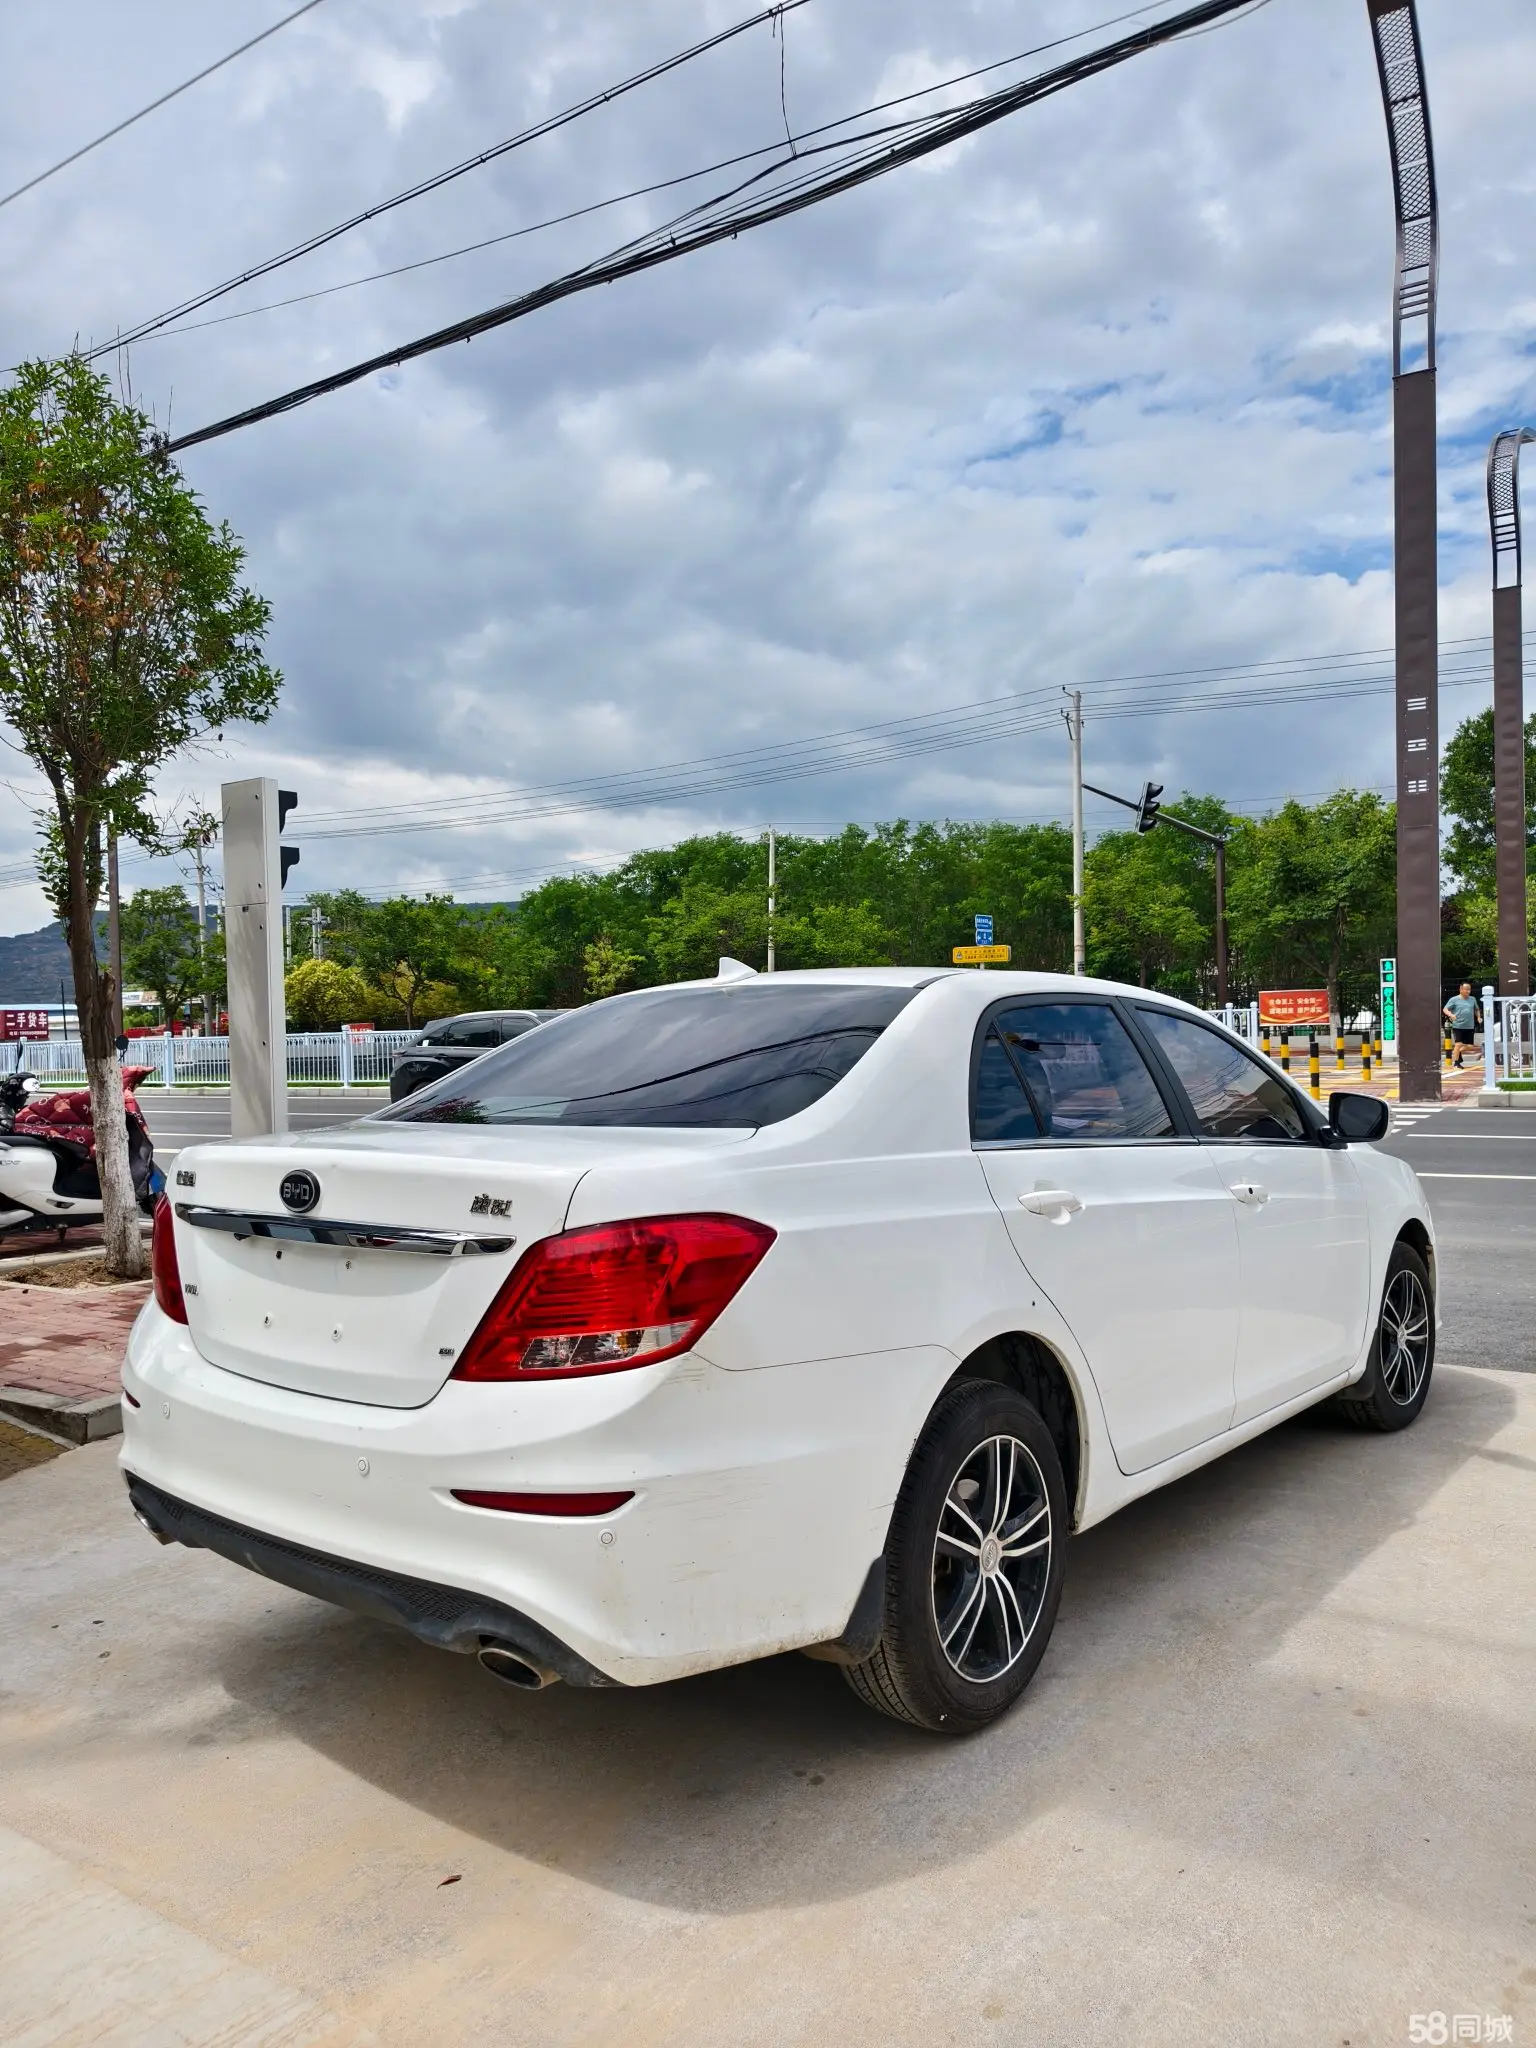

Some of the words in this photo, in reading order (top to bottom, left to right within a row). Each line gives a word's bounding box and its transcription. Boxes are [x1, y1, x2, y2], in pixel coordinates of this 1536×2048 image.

[6, 1012, 47, 1028] 二手货车
[283, 1182, 310, 1200] BYD
